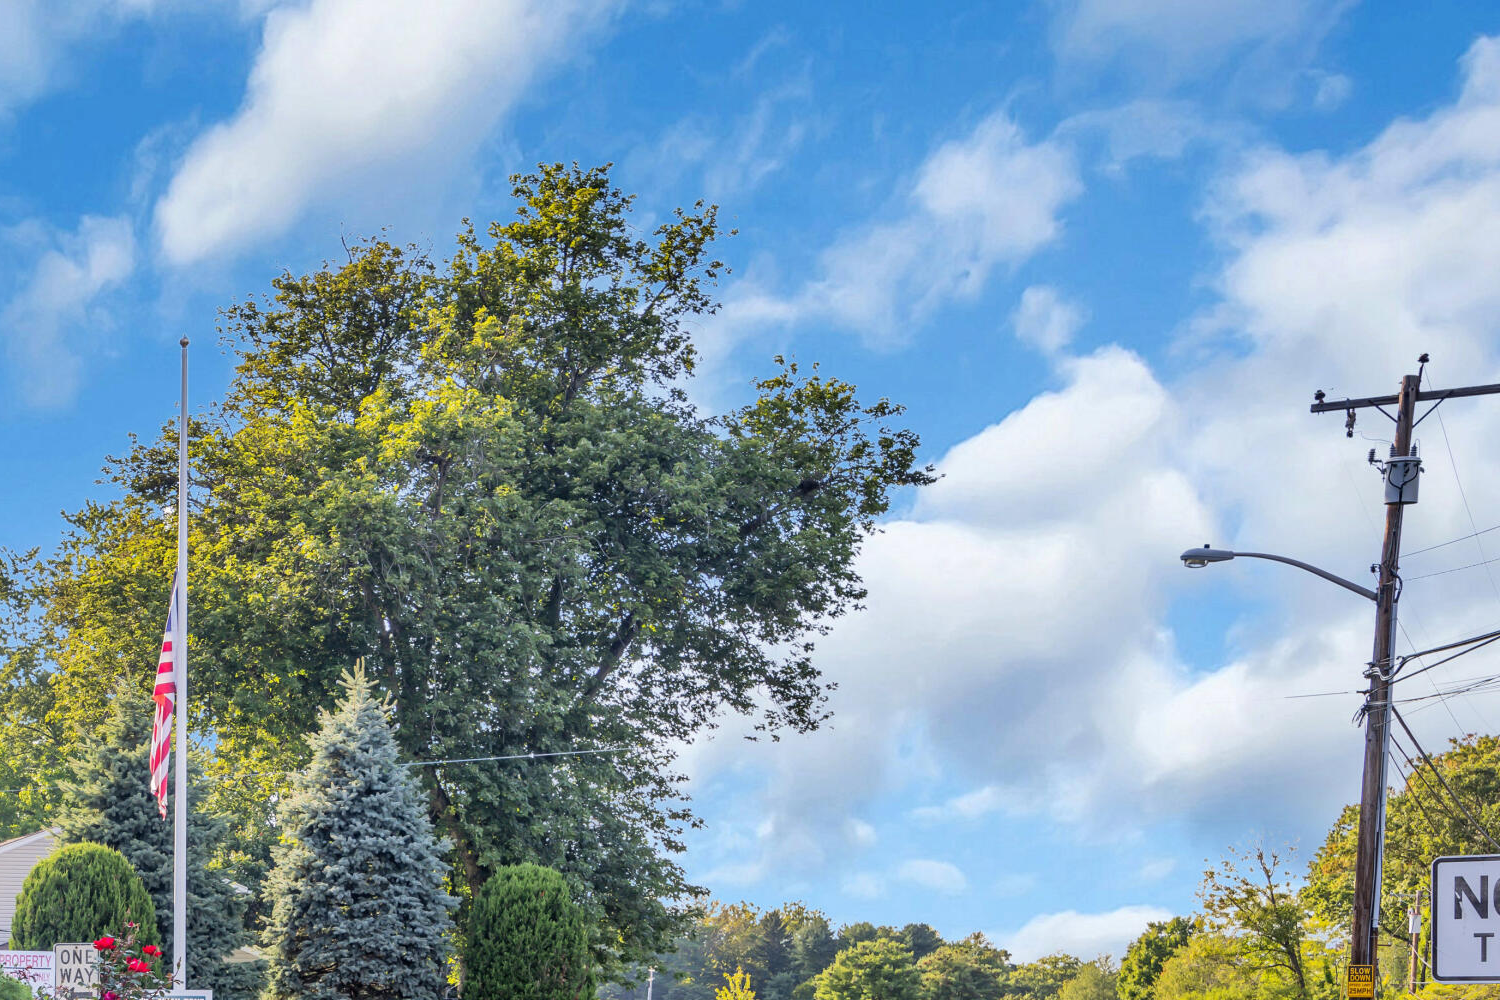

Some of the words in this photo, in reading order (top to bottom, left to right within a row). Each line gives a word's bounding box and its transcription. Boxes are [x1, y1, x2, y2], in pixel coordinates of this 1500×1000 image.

[1454, 875, 1500, 920] N
[60, 949, 95, 965] ONE
[60, 967, 94, 983] WAY
[1350, 967, 1371, 975] SLOW
[1350, 974, 1371, 982] DOWN
